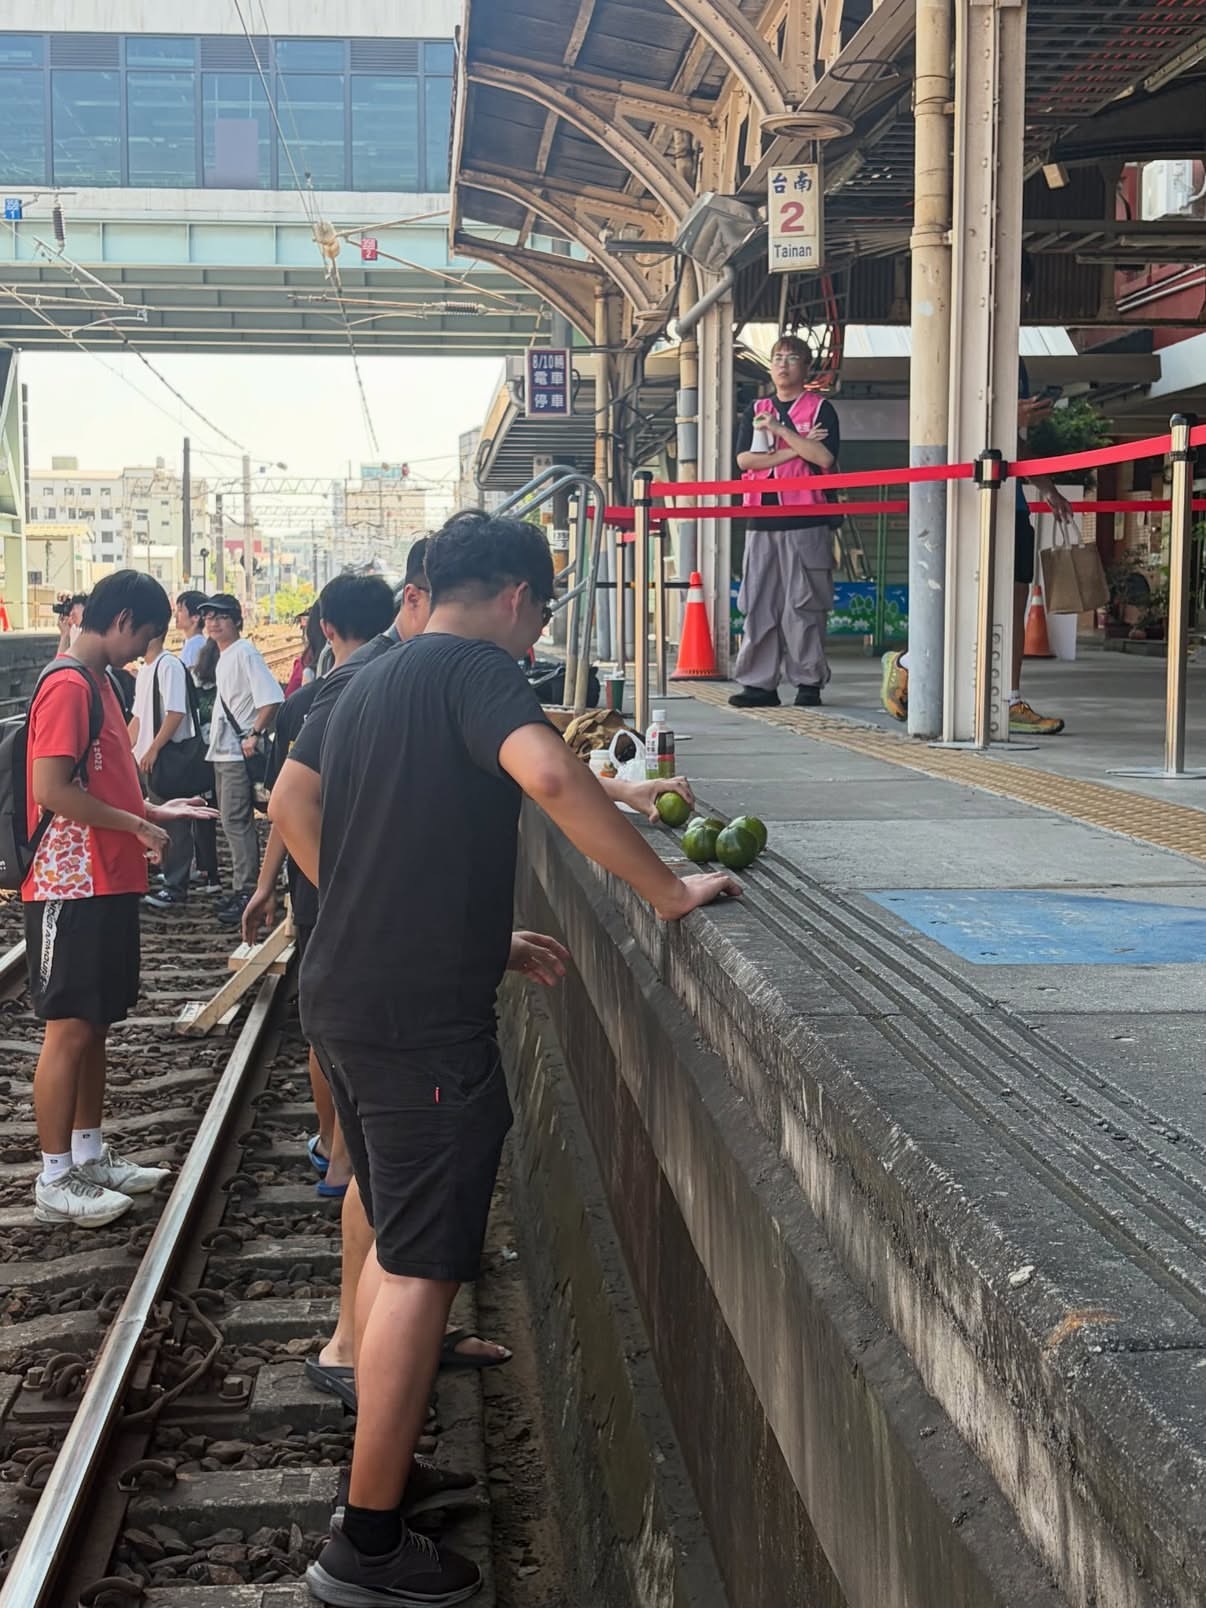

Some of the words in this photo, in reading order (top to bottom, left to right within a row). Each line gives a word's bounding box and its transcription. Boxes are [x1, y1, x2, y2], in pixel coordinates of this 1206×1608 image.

[772, 171, 812, 194] 台南
[780, 201, 805, 233] 2
[774, 243, 812, 258] Tainan
[534, 371, 564, 386] 電車
[535, 393, 564, 408] 停車
[46, 899, 57, 929] NDER
[41, 929, 51, 976] ARMOUR
